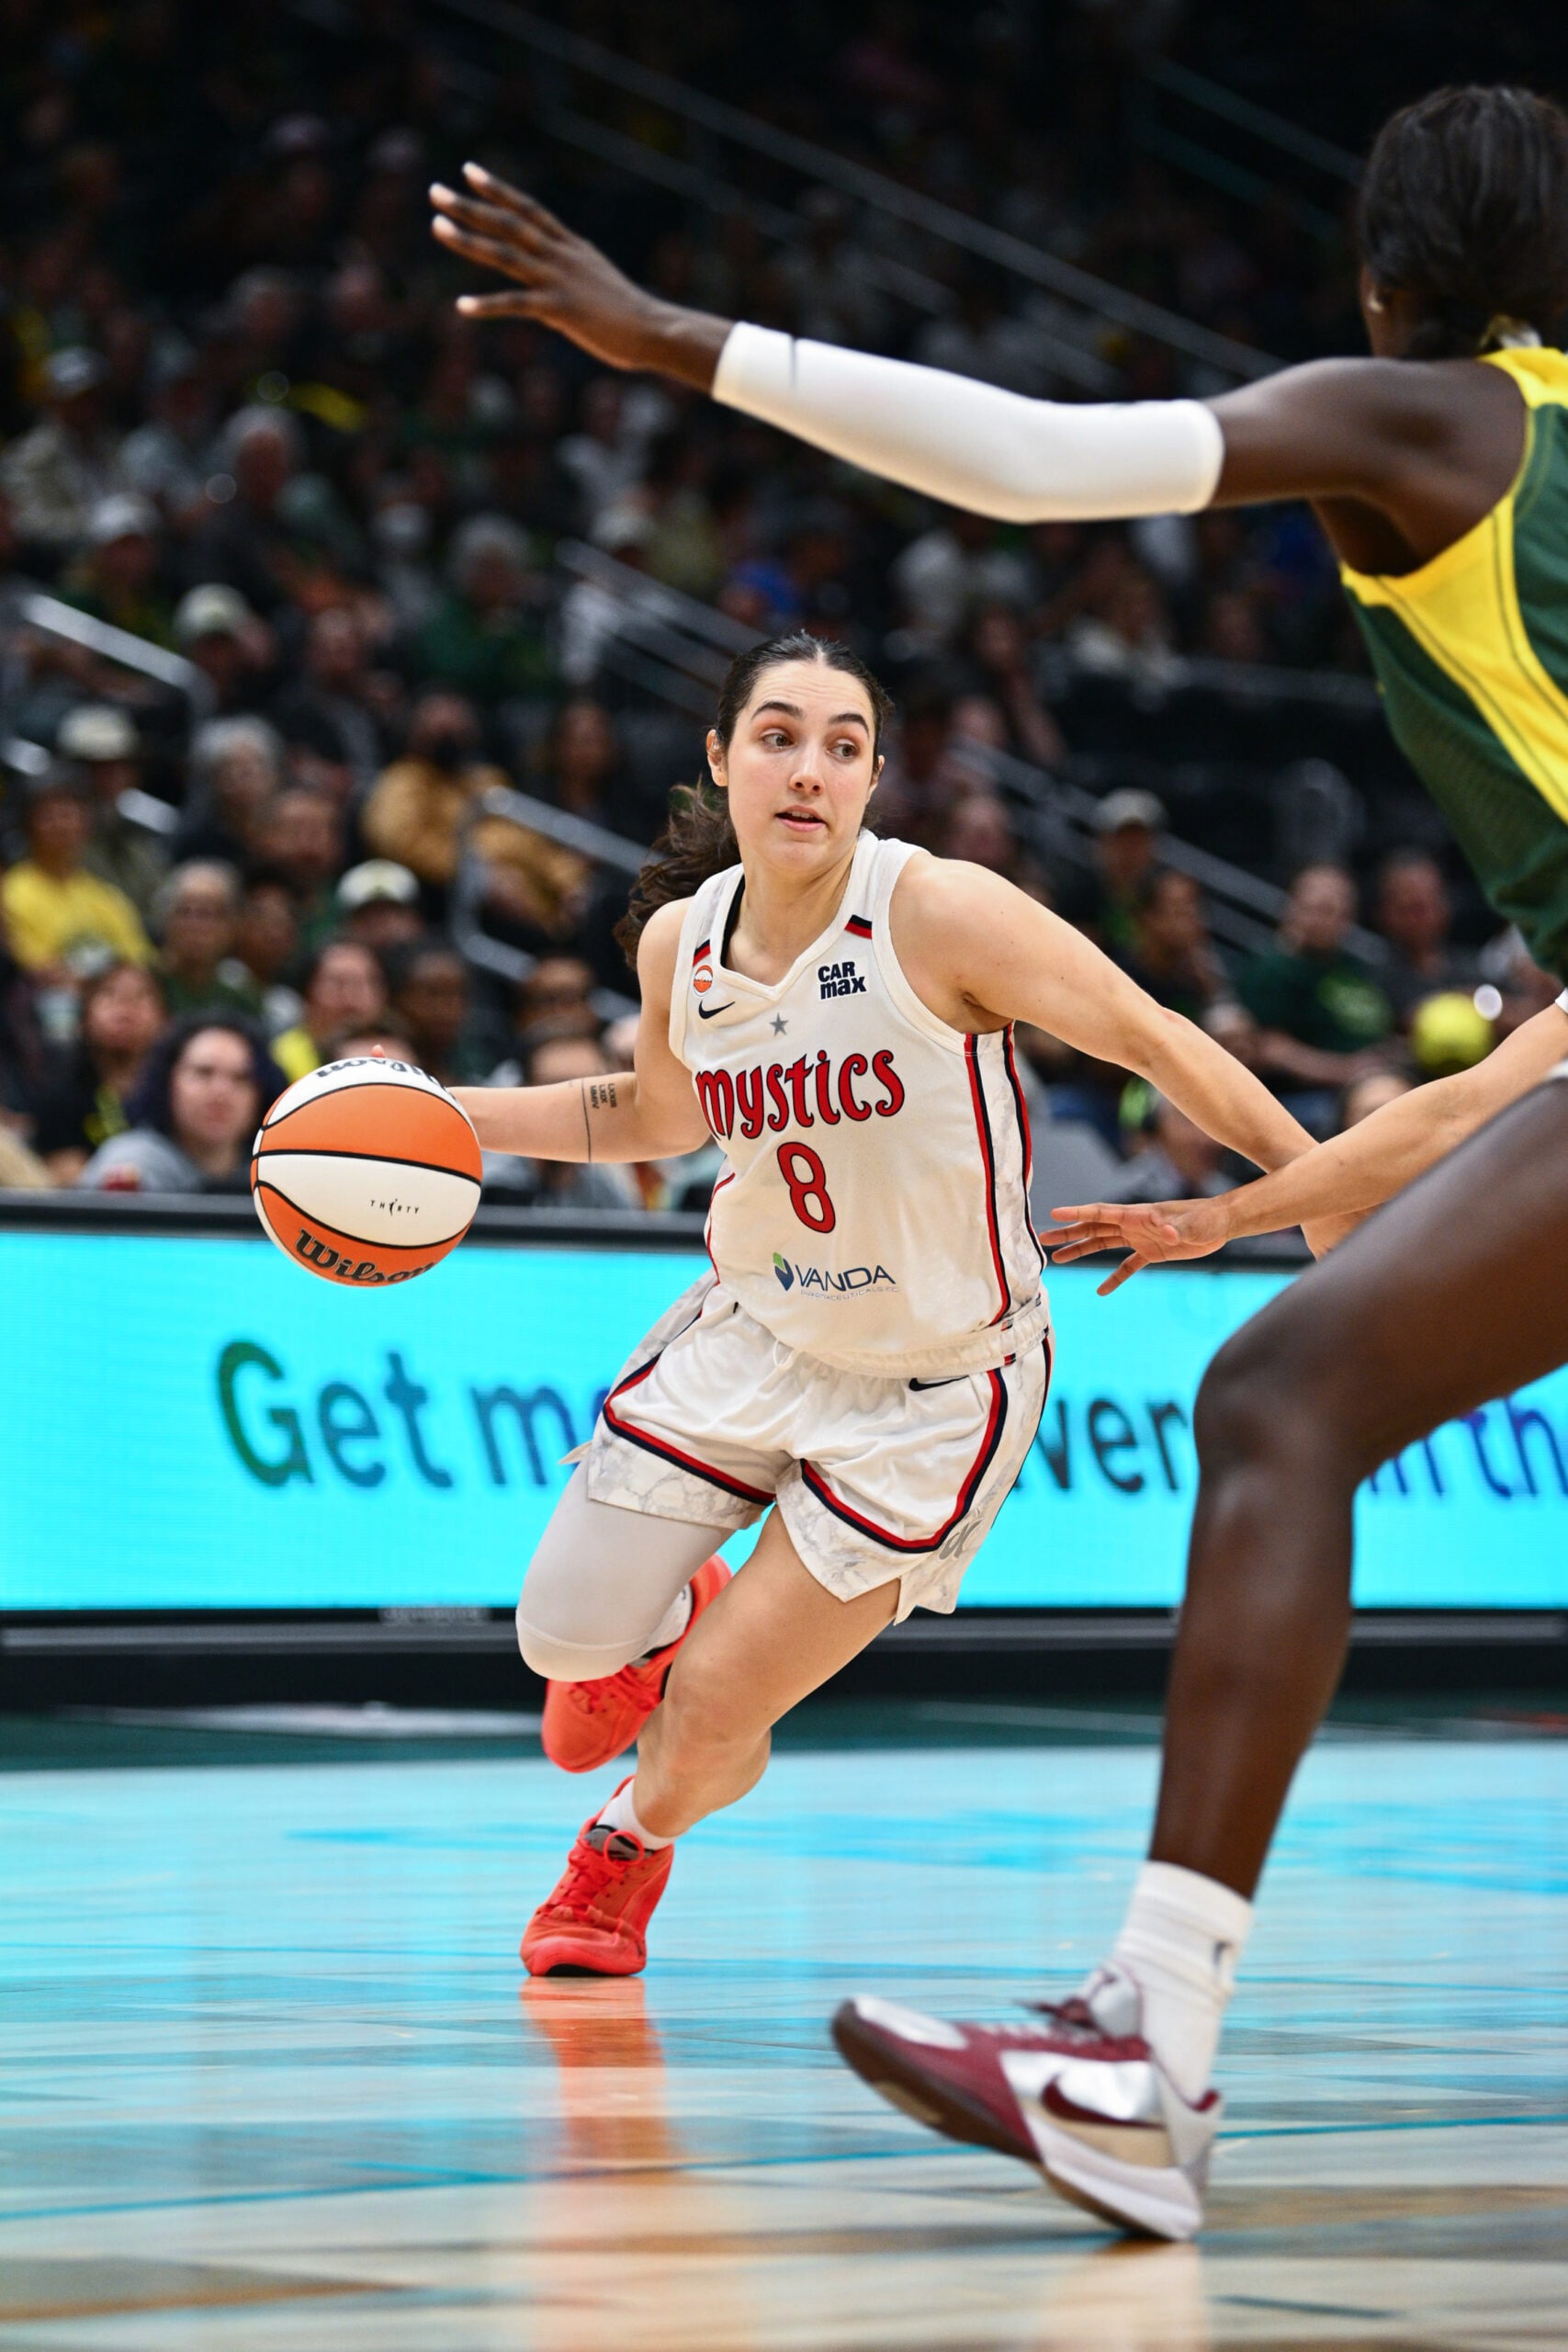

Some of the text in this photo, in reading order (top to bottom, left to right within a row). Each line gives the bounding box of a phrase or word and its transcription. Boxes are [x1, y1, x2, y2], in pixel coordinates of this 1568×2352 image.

[818, 961, 855, 983] CAR
[819, 976, 867, 1000] max
[695, 1049, 905, 1140] mystics
[776, 1141, 837, 1234] 8
[795, 1264, 897, 1292] VANDA
[219, 1340, 453, 1488] Get
